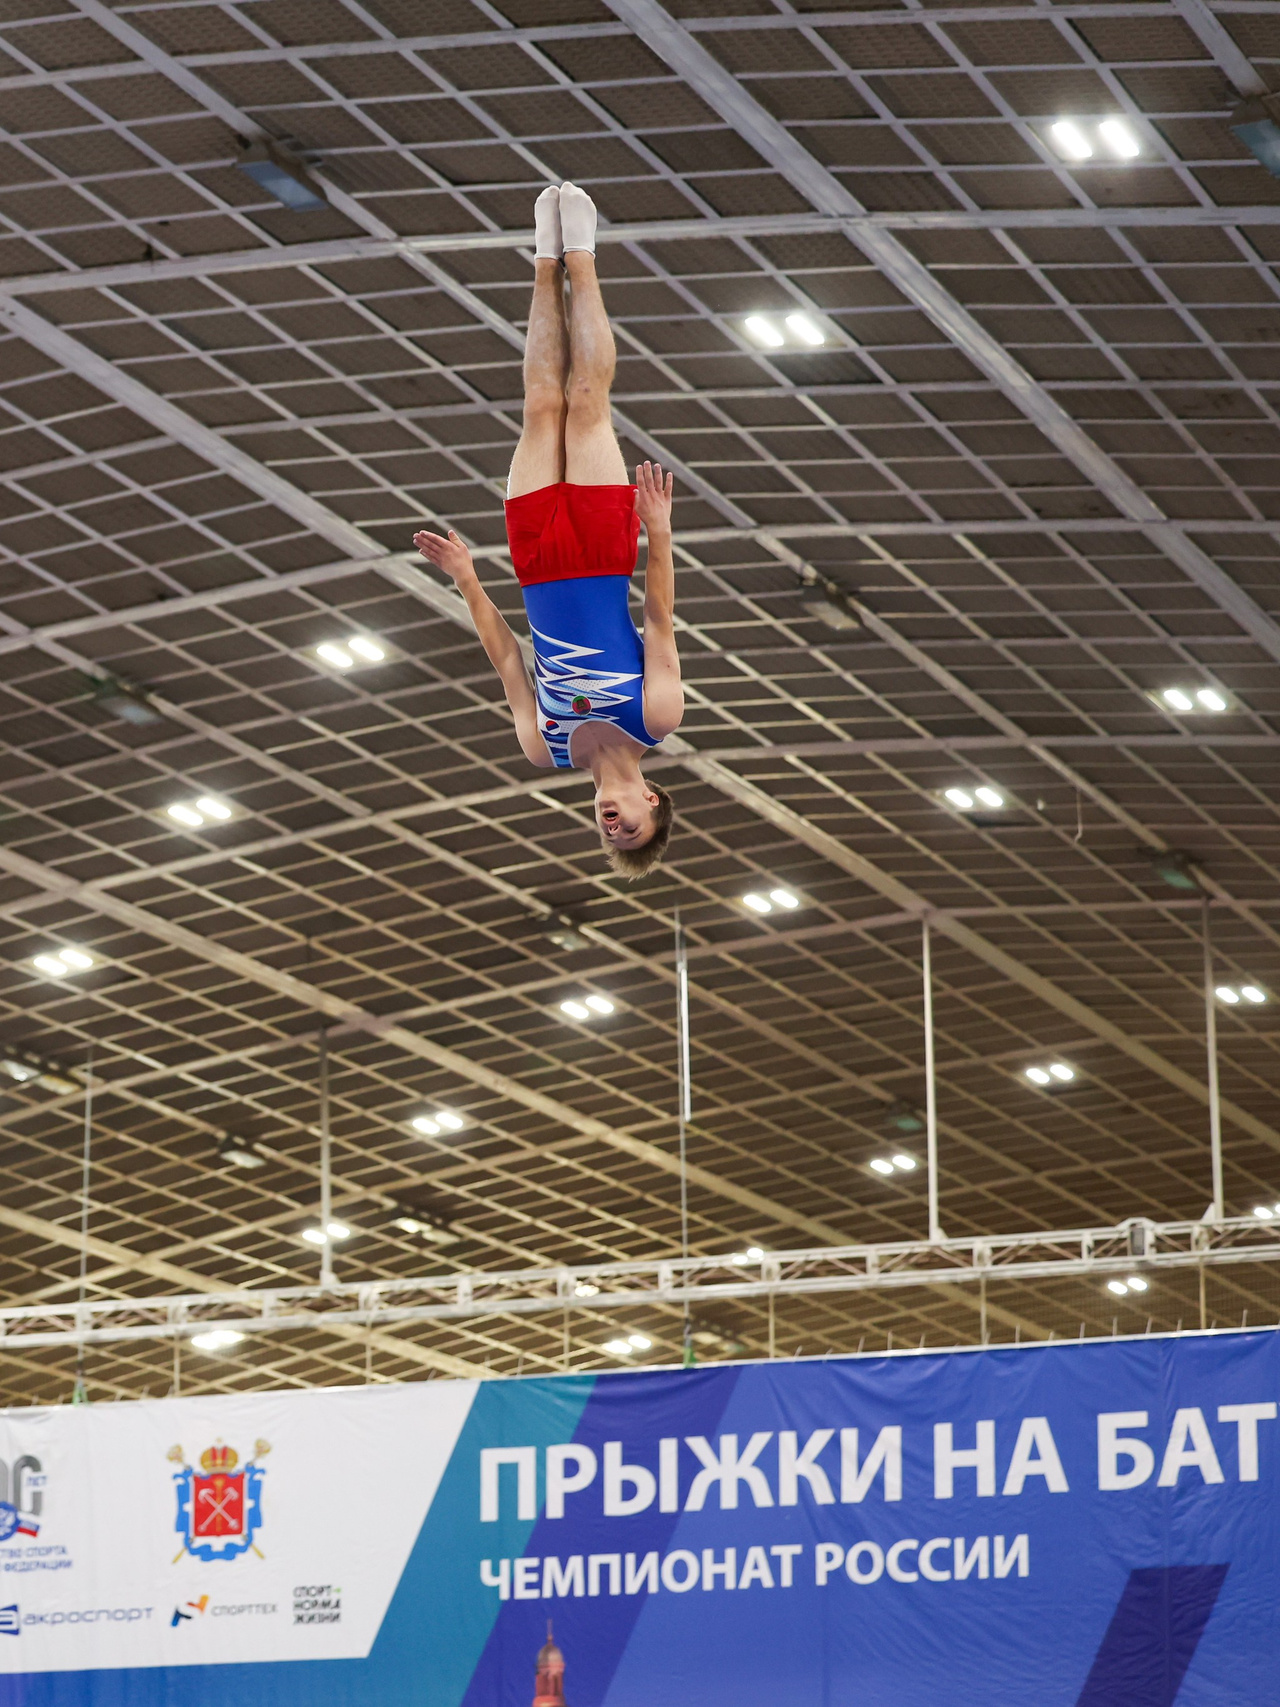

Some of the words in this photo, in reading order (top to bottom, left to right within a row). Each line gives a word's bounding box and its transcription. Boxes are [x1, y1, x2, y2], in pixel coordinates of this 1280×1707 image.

[480, 1425, 903, 1522] ПРЫЖКИ
[933, 1416, 1070, 1500] НА
[480, 1544, 803, 1600] ЧЕМПИОНАТ
[815, 1534, 1029, 1586] РОССИИ
